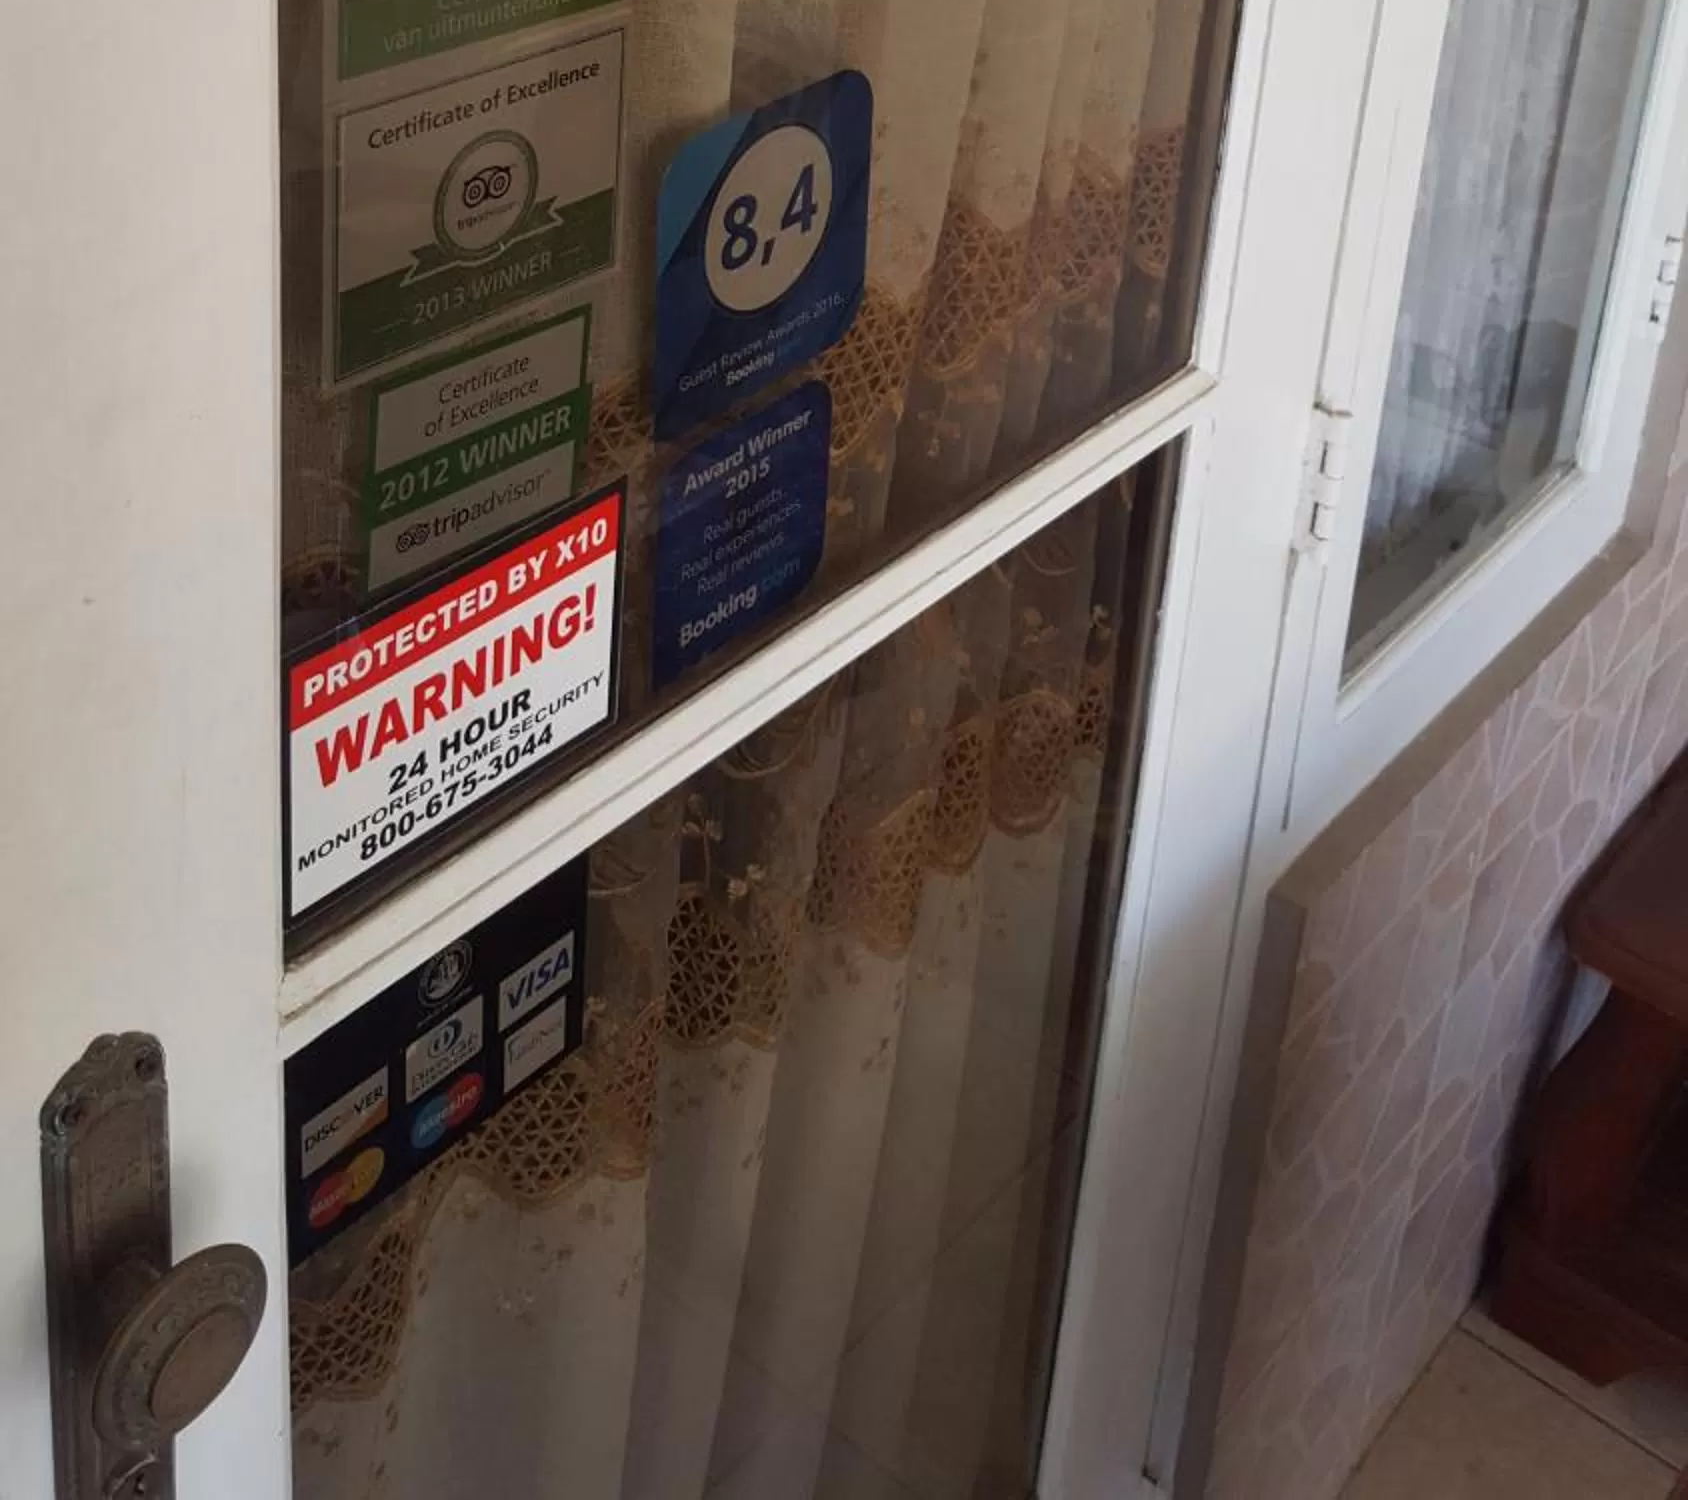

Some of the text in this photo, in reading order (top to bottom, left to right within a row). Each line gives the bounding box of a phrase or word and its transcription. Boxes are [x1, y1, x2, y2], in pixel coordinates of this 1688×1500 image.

[383, 26, 423, 53] van
[367, 61, 601, 150] Certificate of Excellence
[721, 163, 819, 271] 8,4
[412, 251, 553, 326] 2013 WINNER
[423, 376, 540, 438] of Excellence
[437, 355, 530, 405] Certificate
[378, 404, 573, 512] 2012 WINNER
[682, 408, 813, 497] Award Winner
[724, 455, 772, 500] 2015
[432, 472, 548, 538] tripadvisor
[302, 517, 608, 710] PROTECTED BY X10
[313, 582, 598, 790] WARNING!
[297, 669, 605, 873] MONITORED HOME SECURITY
[387, 687, 532, 796] 24 HOUR
[359, 722, 556, 863] 800-675-3044
[507, 946, 570, 1010] VISA
[303, 1085, 383, 1154] DISCVER
